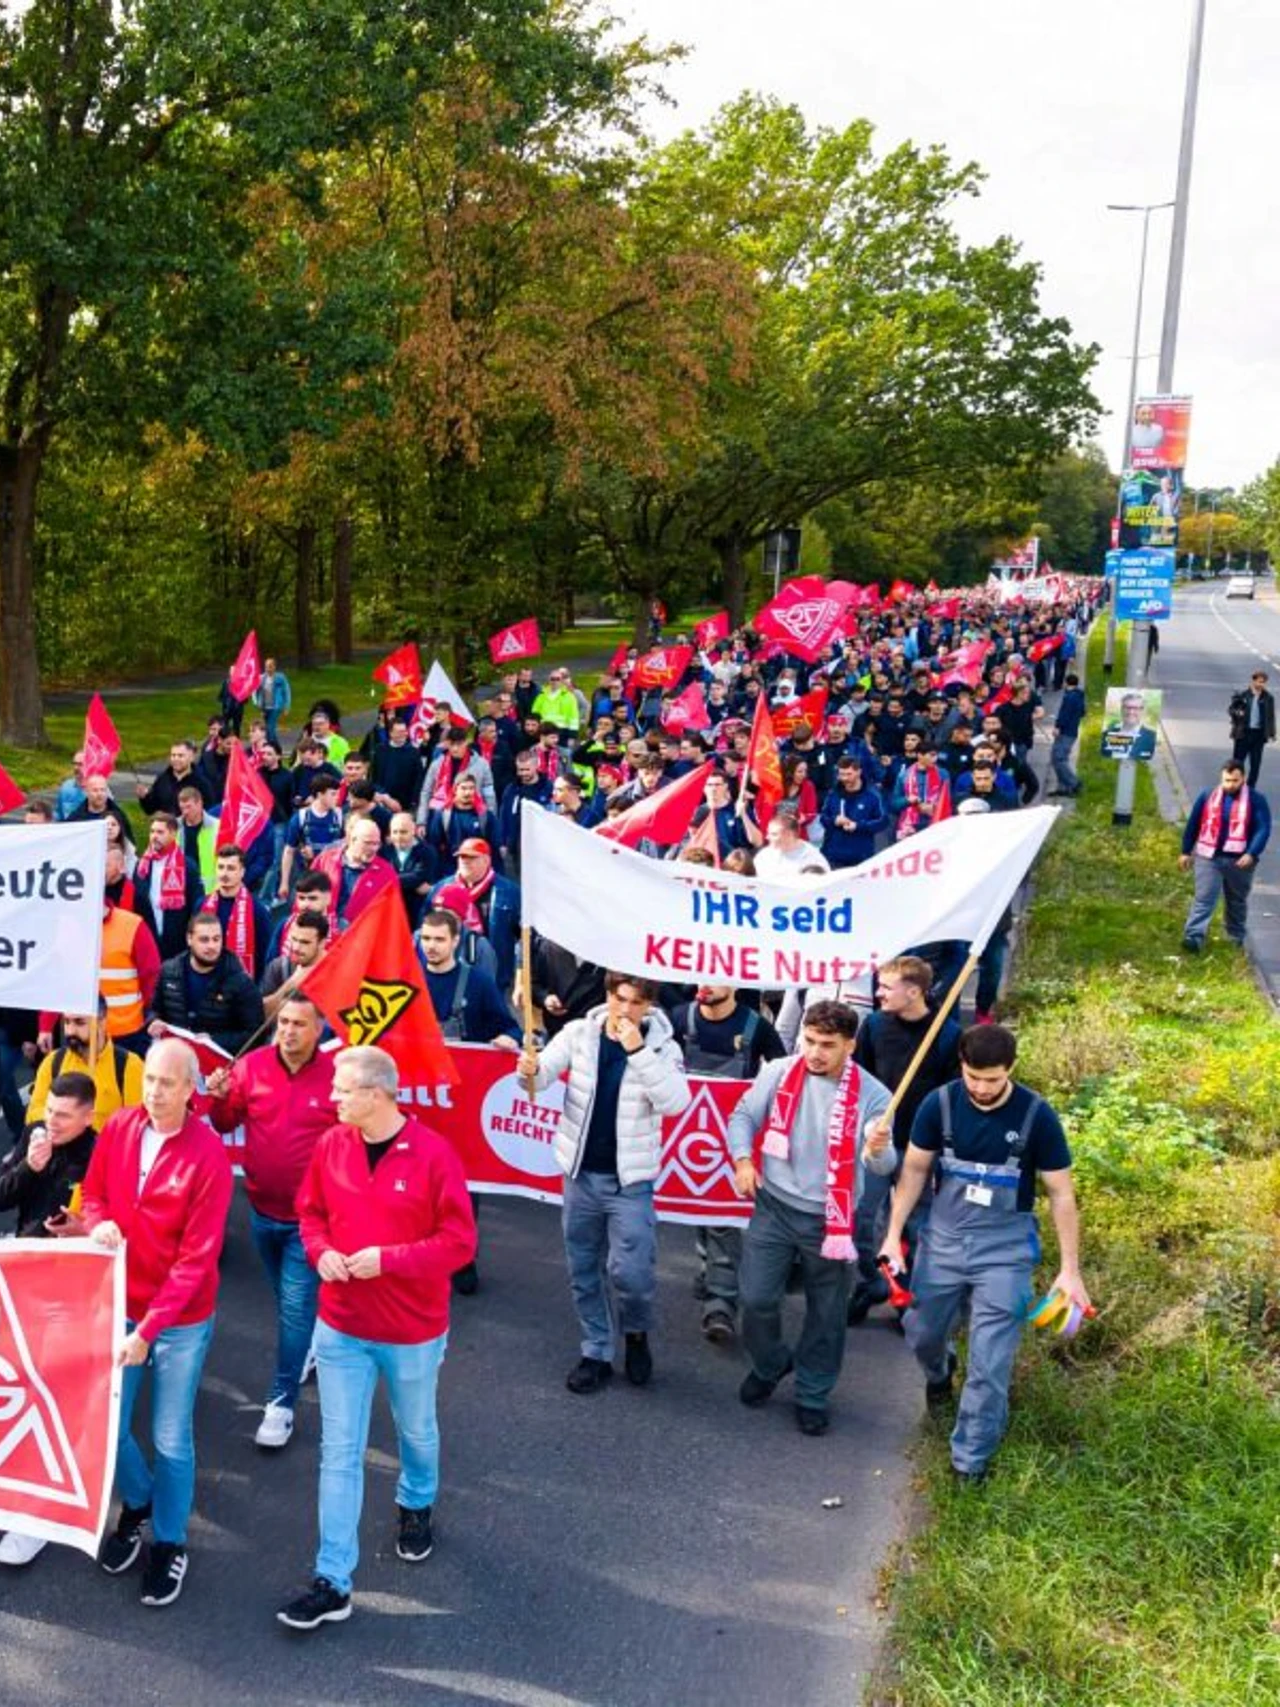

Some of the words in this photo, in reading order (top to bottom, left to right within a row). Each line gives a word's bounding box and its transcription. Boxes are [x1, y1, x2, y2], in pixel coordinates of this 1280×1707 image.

[692, 889, 759, 929] IHR
[772, 897, 853, 933] seid
[644, 934, 760, 980] KEINE
[511, 1097, 563, 1126] JETZT
